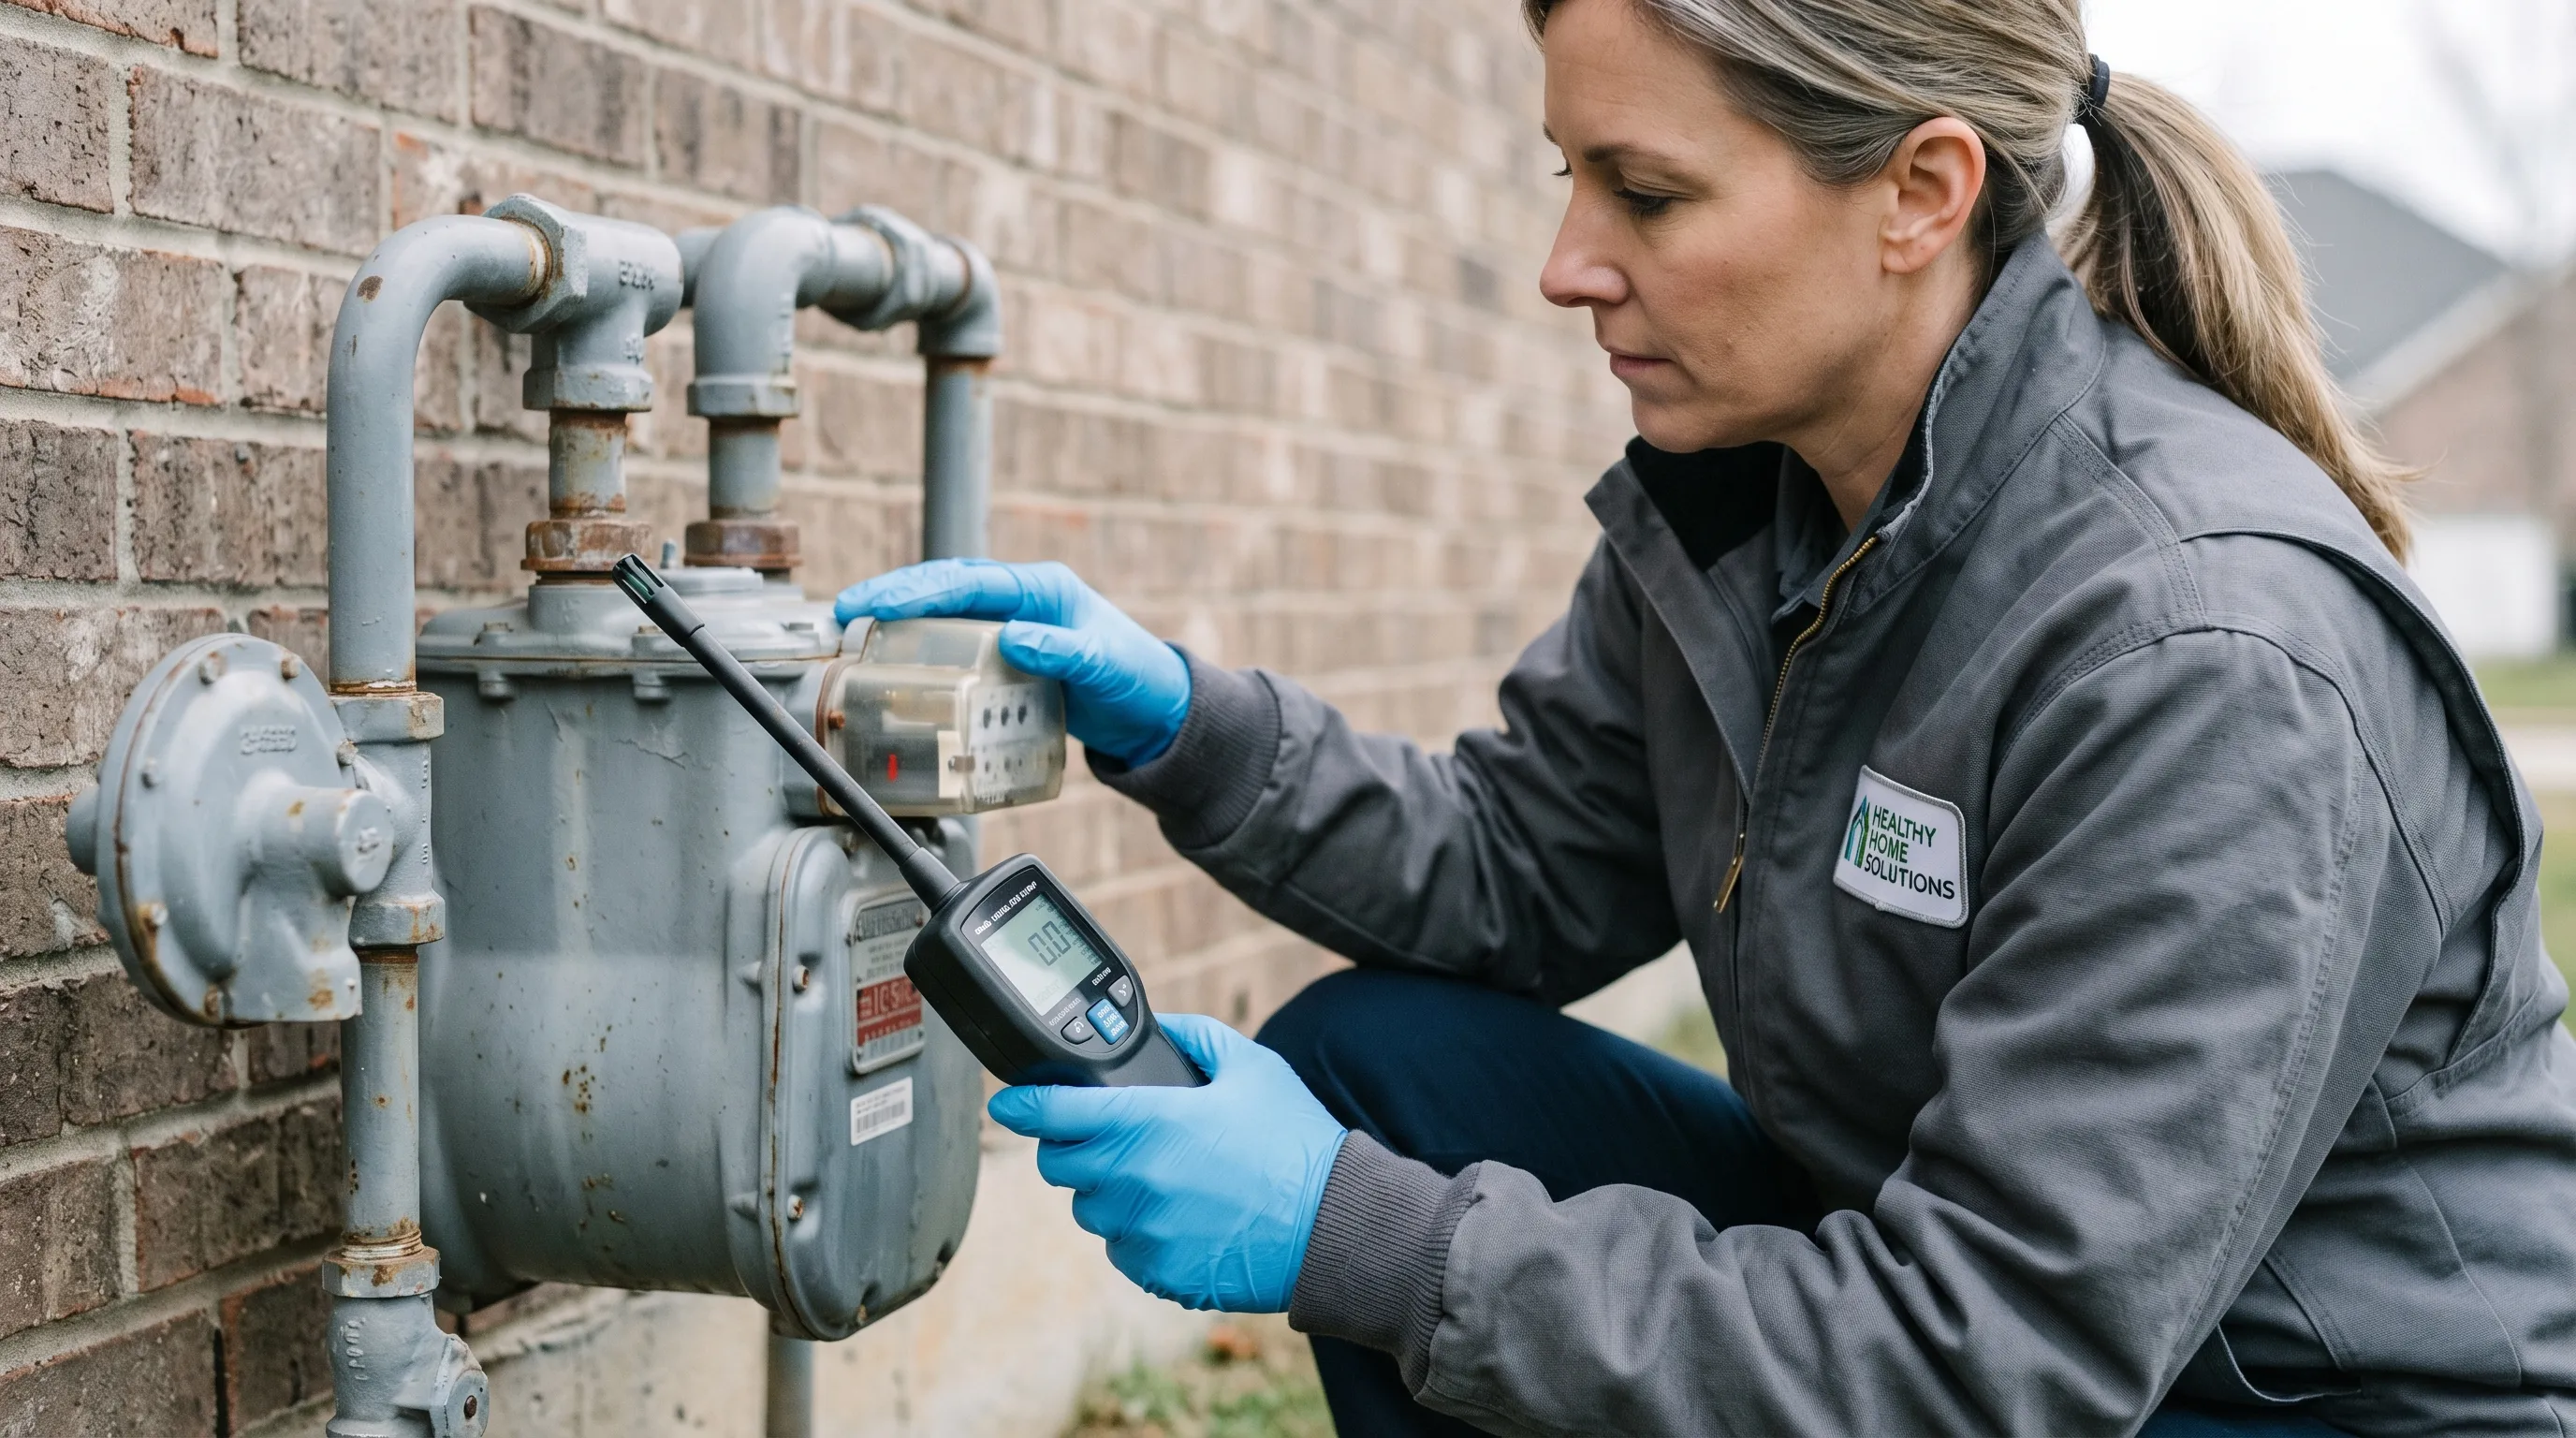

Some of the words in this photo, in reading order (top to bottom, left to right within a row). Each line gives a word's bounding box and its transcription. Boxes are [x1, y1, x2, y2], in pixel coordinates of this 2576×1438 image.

[1869, 830, 1909, 863] HOME
[1873, 805, 1936, 847] HEALTHY
[1864, 854, 1954, 900] SOLUTIONS
[1028, 920, 1072, 967] 0.0
